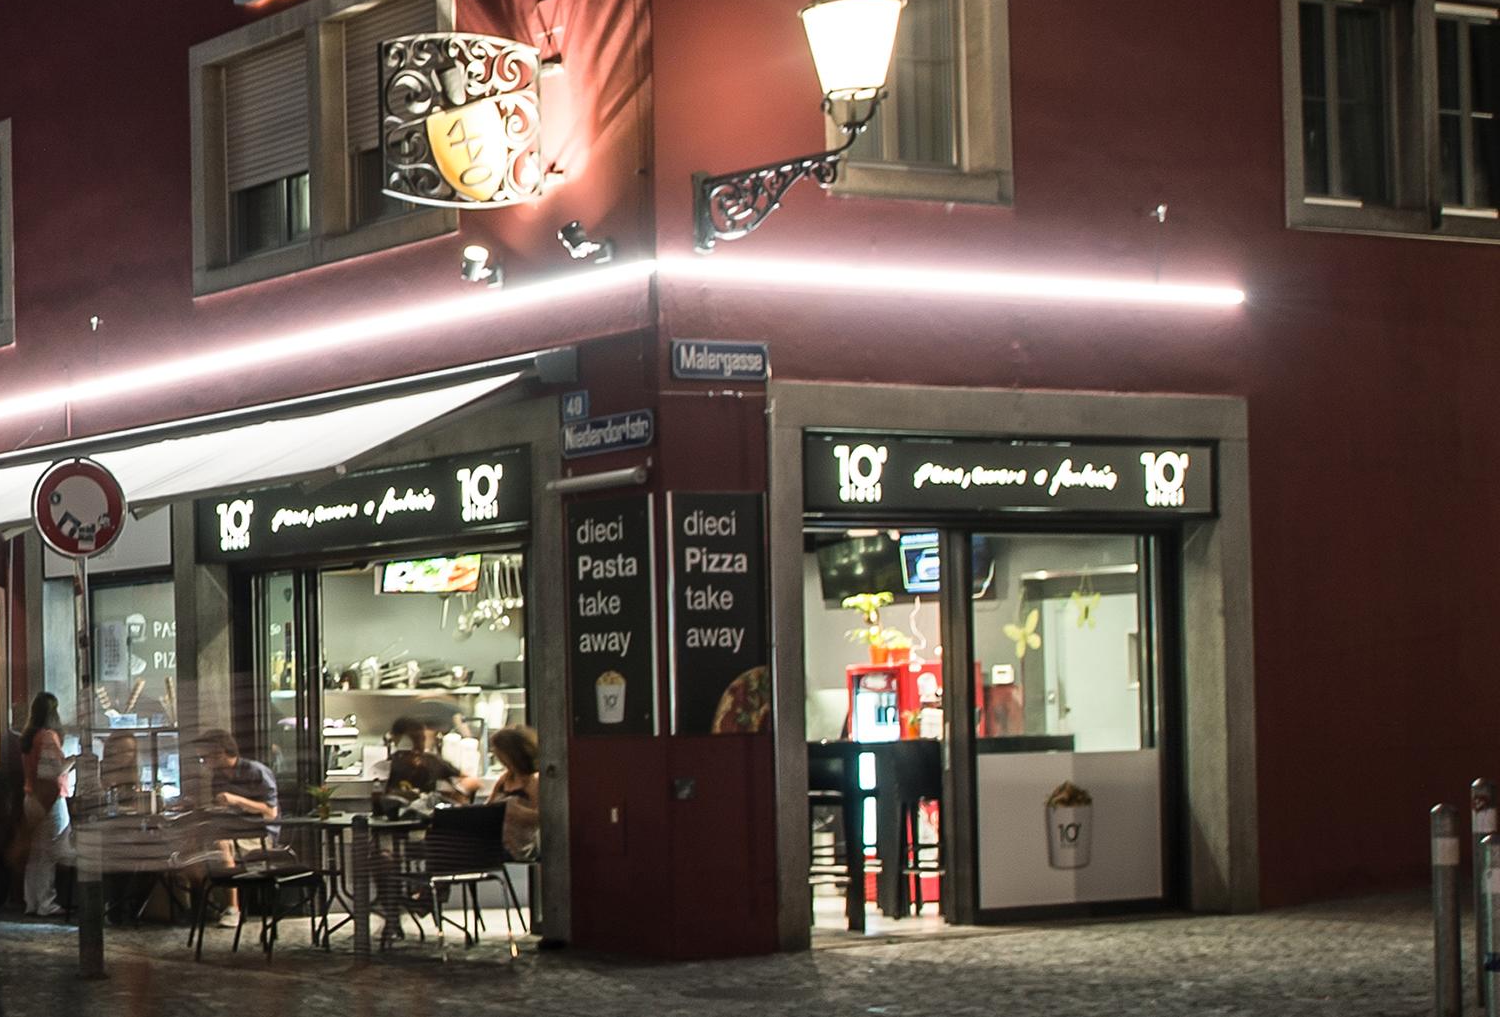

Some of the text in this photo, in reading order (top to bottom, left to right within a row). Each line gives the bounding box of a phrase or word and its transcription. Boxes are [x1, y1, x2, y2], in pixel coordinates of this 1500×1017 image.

[680, 344, 763, 377] Malergasse
[577, 515, 624, 544] dieci
[684, 510, 737, 536] dieci
[578, 552, 638, 581] Pasta
[685, 547, 748, 574] Pizza
[579, 590, 621, 616] take
[685, 585, 734, 611] take
[580, 631, 631, 657] away
[686, 622, 745, 653] away
